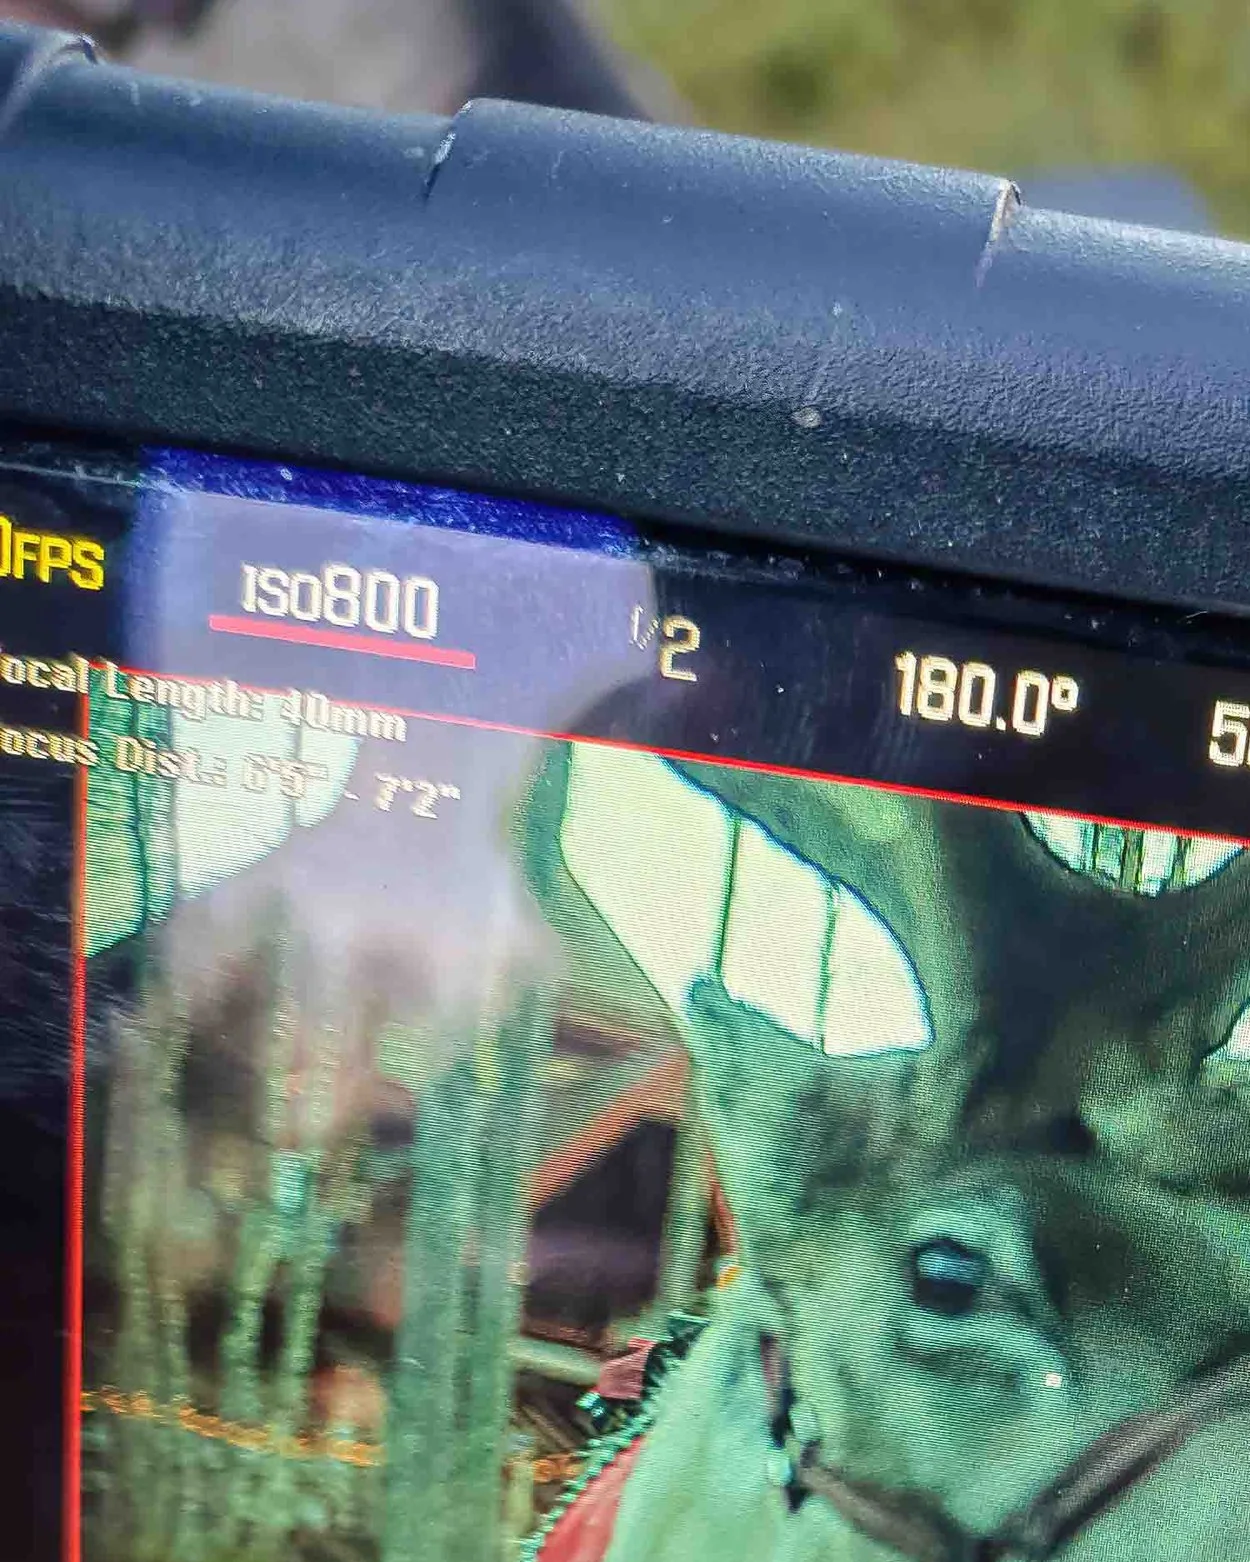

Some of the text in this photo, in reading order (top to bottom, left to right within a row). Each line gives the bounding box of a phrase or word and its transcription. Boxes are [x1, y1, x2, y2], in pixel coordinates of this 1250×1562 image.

[241, 563, 440, 640] ISO800
[0, 652, 90, 696] ocal
[104, 656, 264, 721] Length:
[894, 650, 1080, 737] 180.0°
[0, 726, 98, 768] ocus
